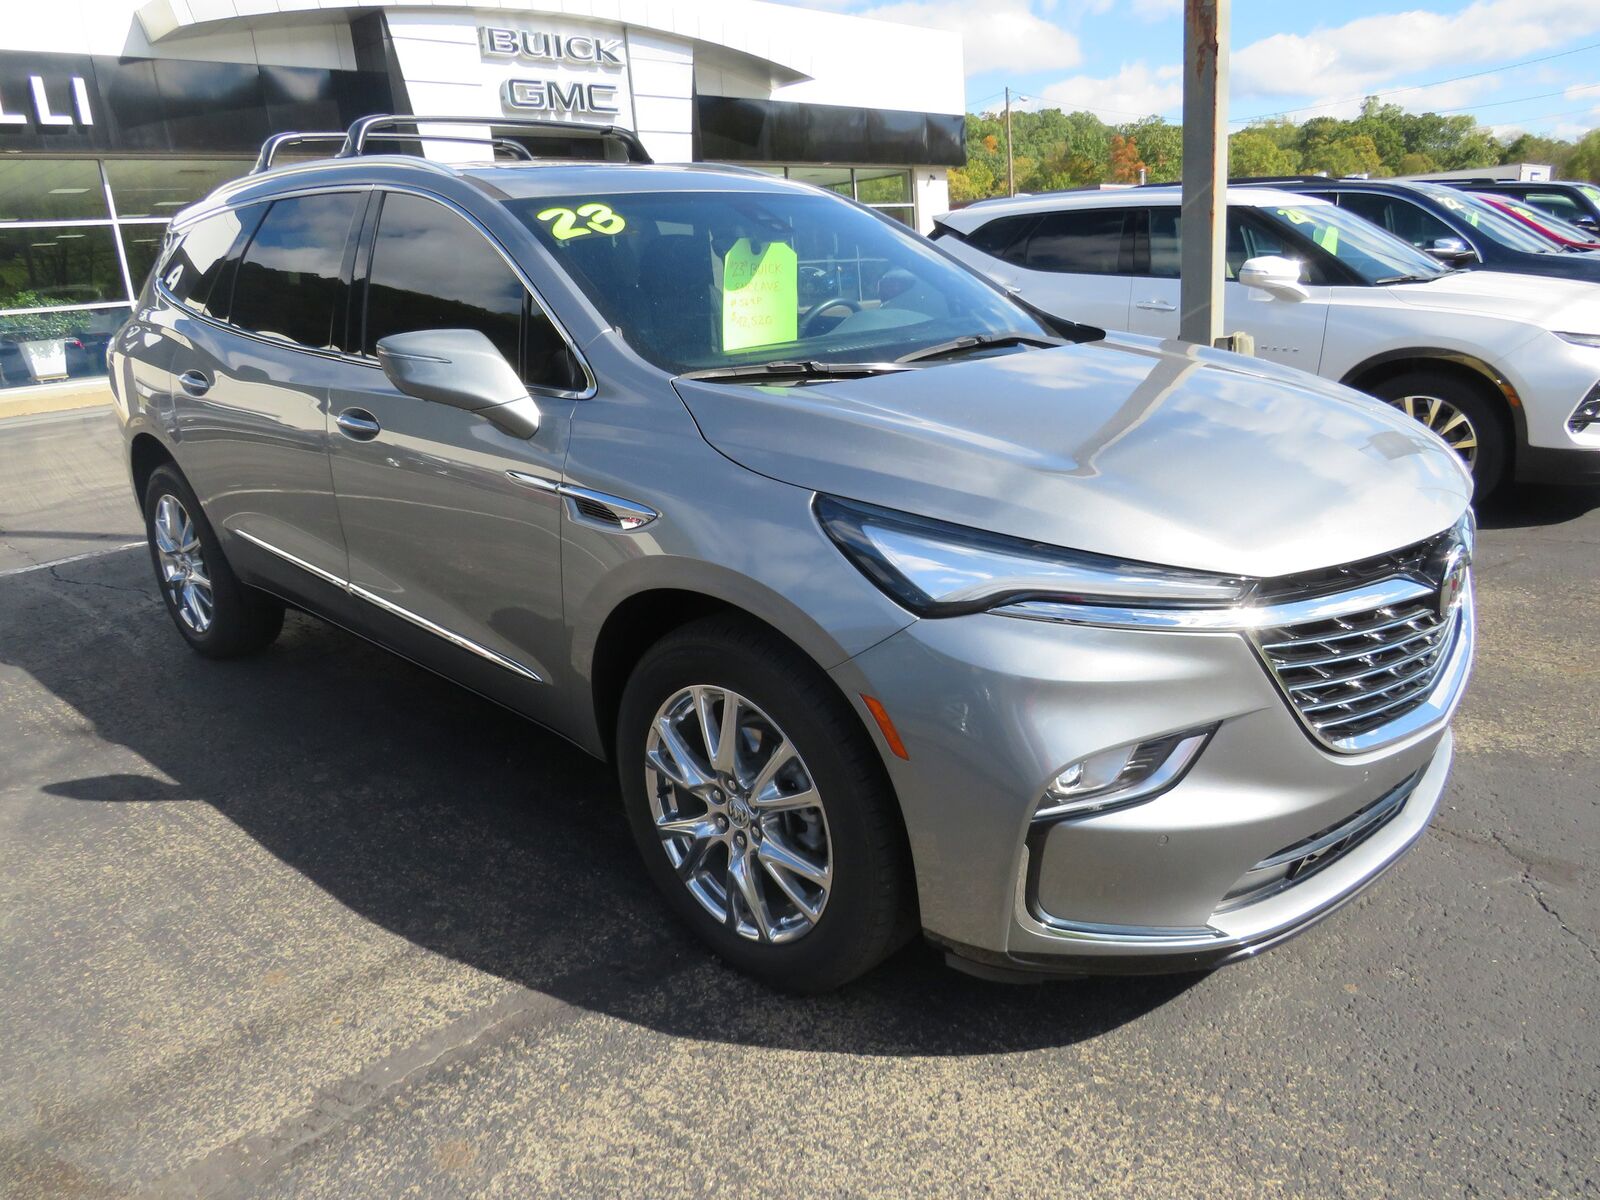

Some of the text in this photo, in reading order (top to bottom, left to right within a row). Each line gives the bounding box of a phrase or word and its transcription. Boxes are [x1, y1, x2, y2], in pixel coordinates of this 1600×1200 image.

[482, 26, 625, 66] BUICK
[502, 78, 620, 116] GMC
[536, 203, 626, 240] 23
[750, 263, 783, 277] BUICK
